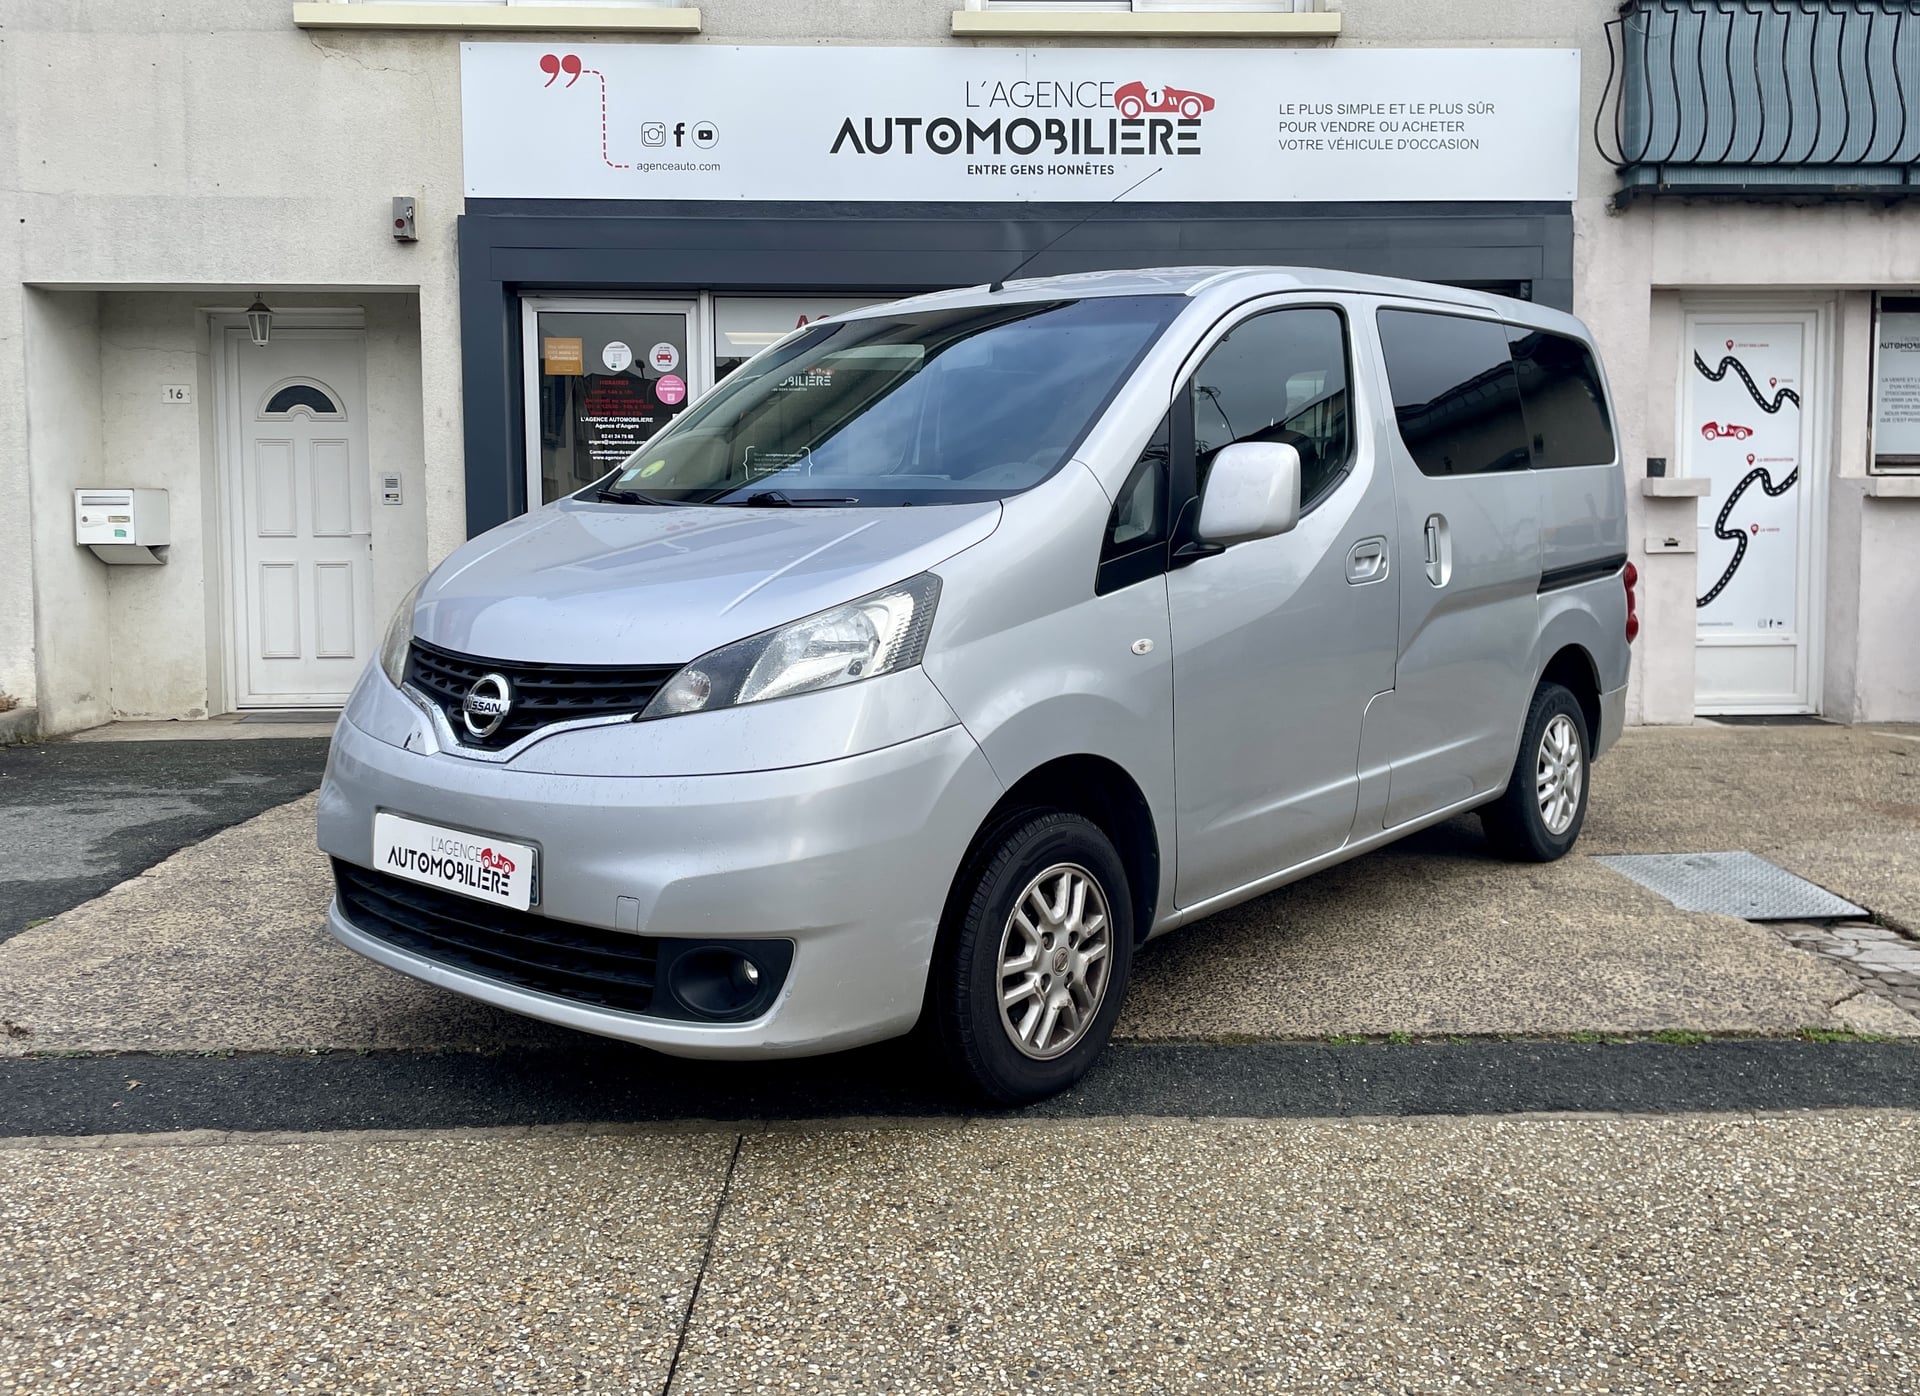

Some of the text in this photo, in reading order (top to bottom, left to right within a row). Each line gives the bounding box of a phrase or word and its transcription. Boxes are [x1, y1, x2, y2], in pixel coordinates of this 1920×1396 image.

[966, 81, 1115, 108] L'AGENCE
[1279, 101, 1495, 115] LE PLUS SIMPLE ET LE PLUS SÛR
[1279, 121, 1465, 132] POUR VENDRE OU ACHETER
[1279, 136, 1479, 150] VOTRE VÉHICULE D'OCCASION
[636, 162, 721, 172] agenceauto.com
[967, 162, 1115, 175] ENTRE GENS HONNÊTES
[169, 388, 184, 400] 16
[431, 836, 482, 863] L'AGENCE
